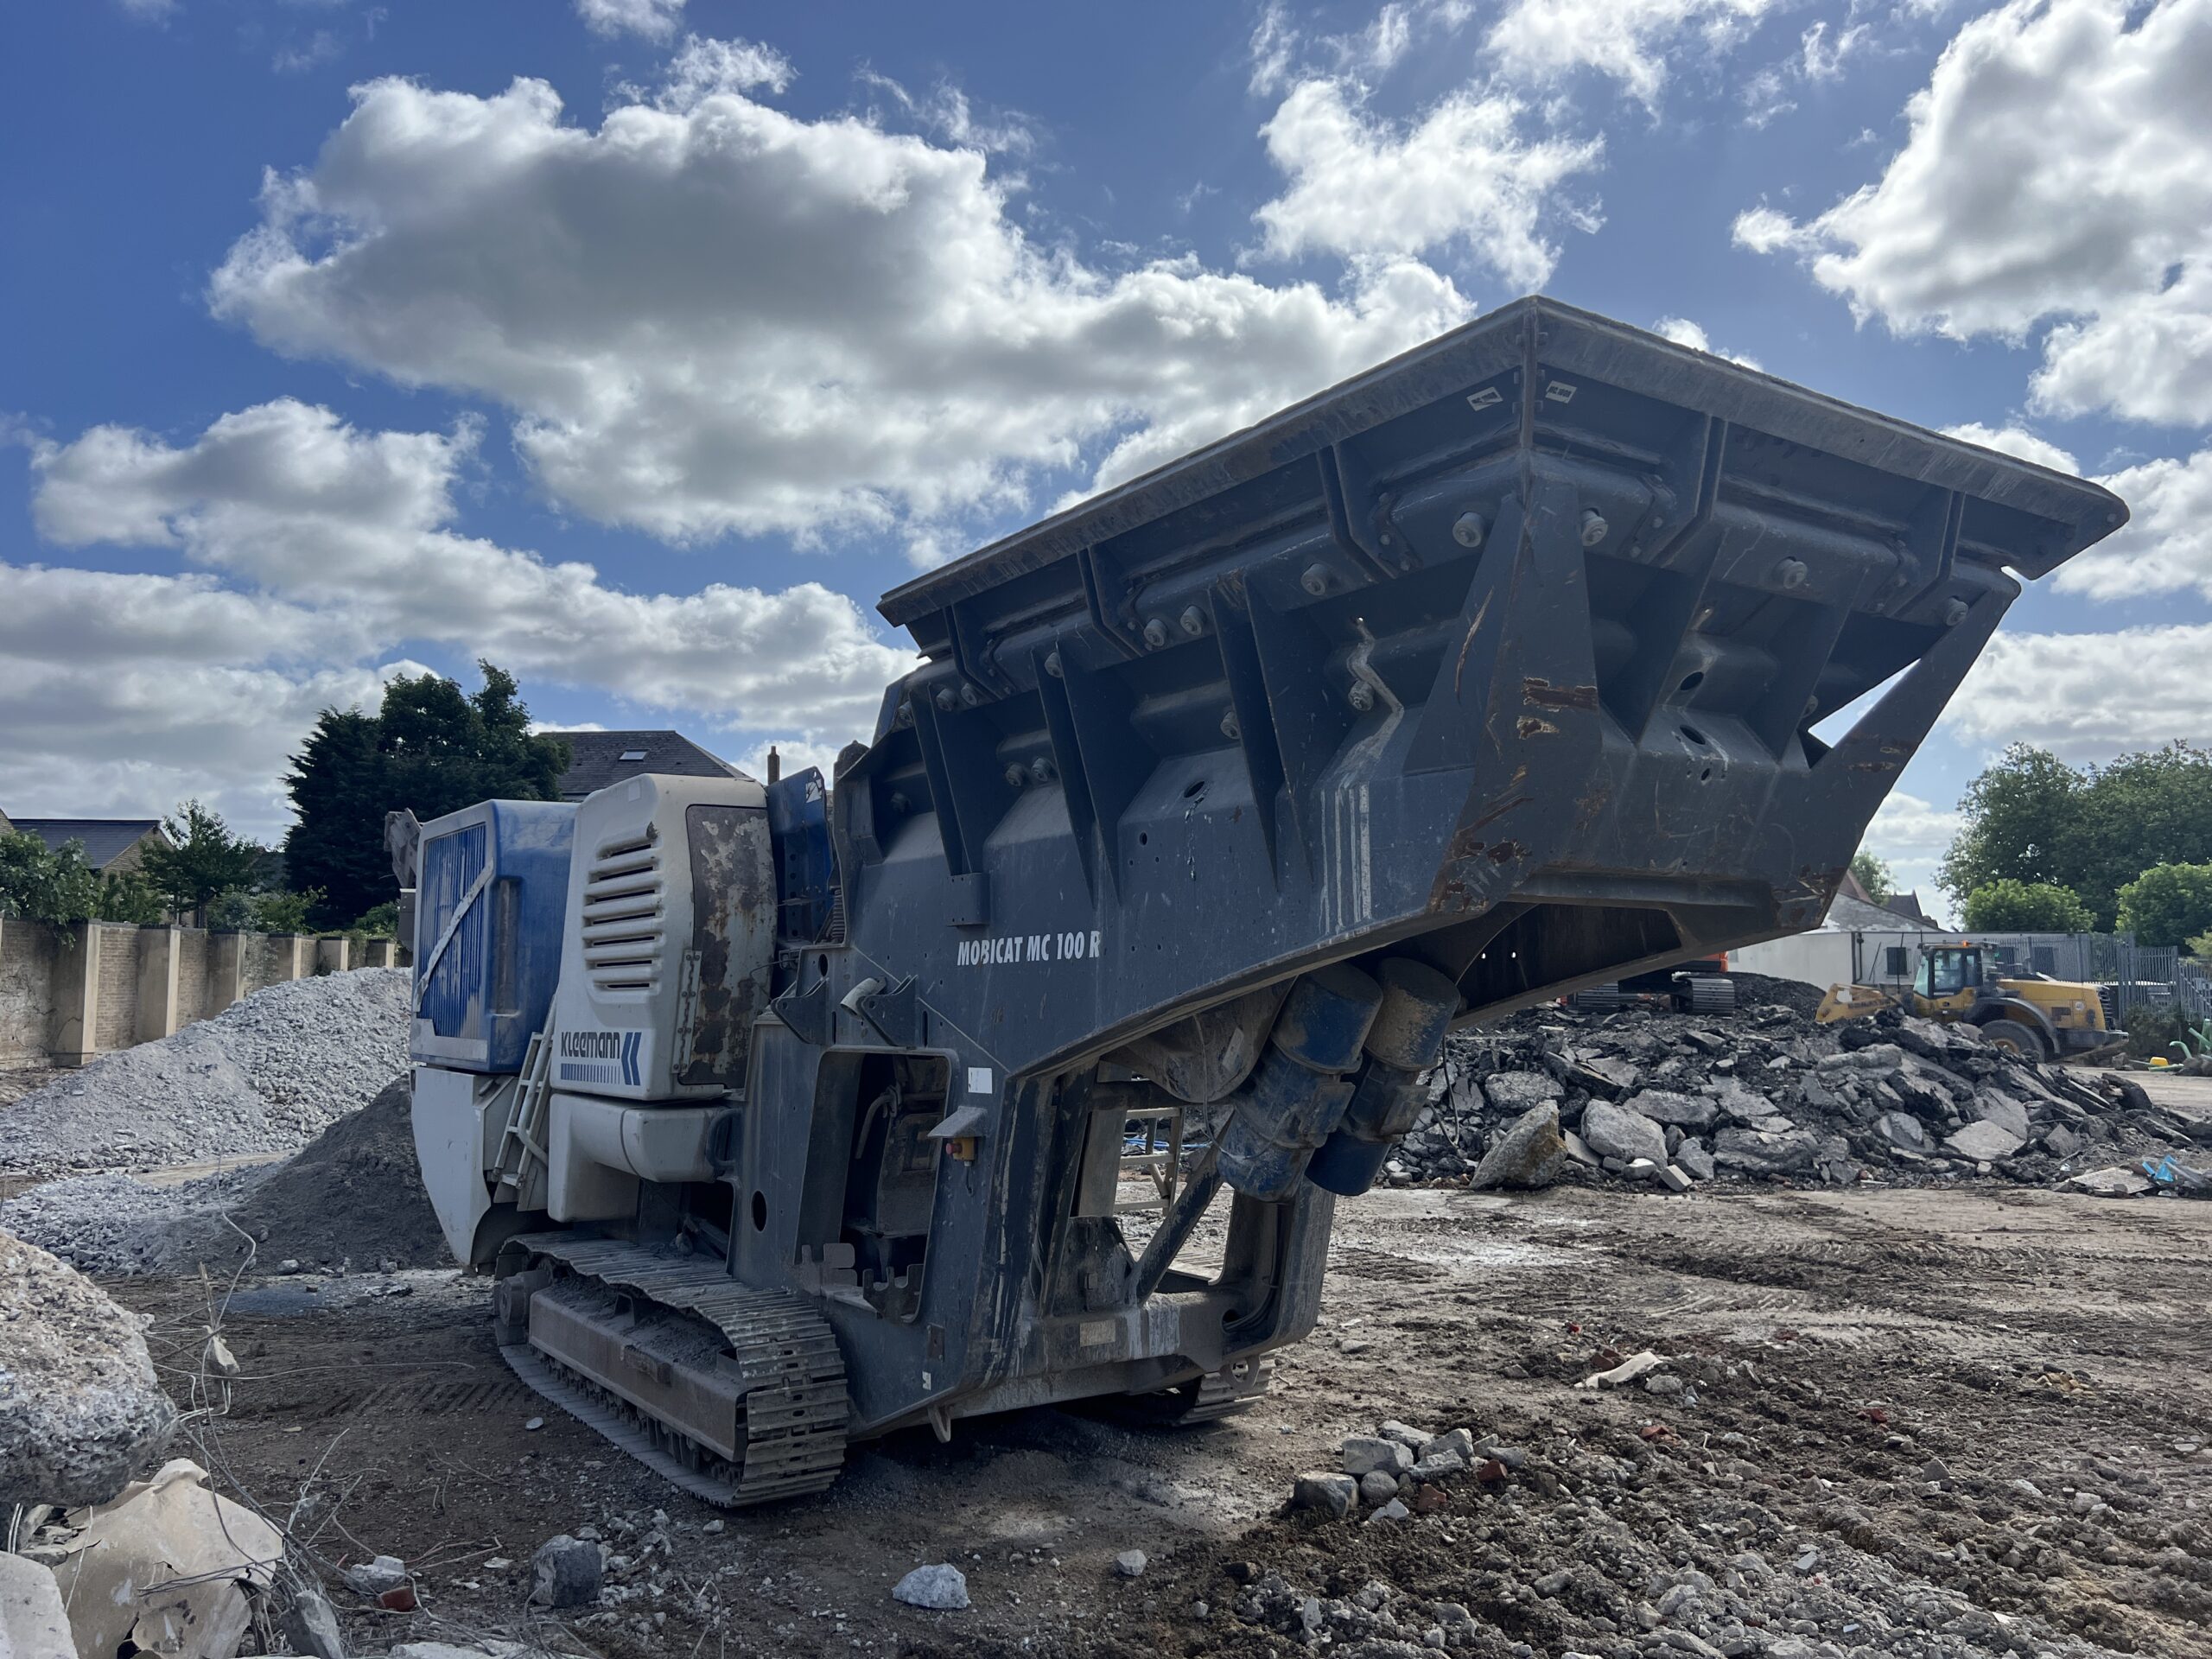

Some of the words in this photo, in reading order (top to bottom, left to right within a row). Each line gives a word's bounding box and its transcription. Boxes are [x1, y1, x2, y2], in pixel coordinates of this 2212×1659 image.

[957, 937, 1023, 965] MOBICAT
[1027, 933, 1051, 962] MC
[1057, 931, 1084, 959] 100
[1089, 931, 1101, 957] R
